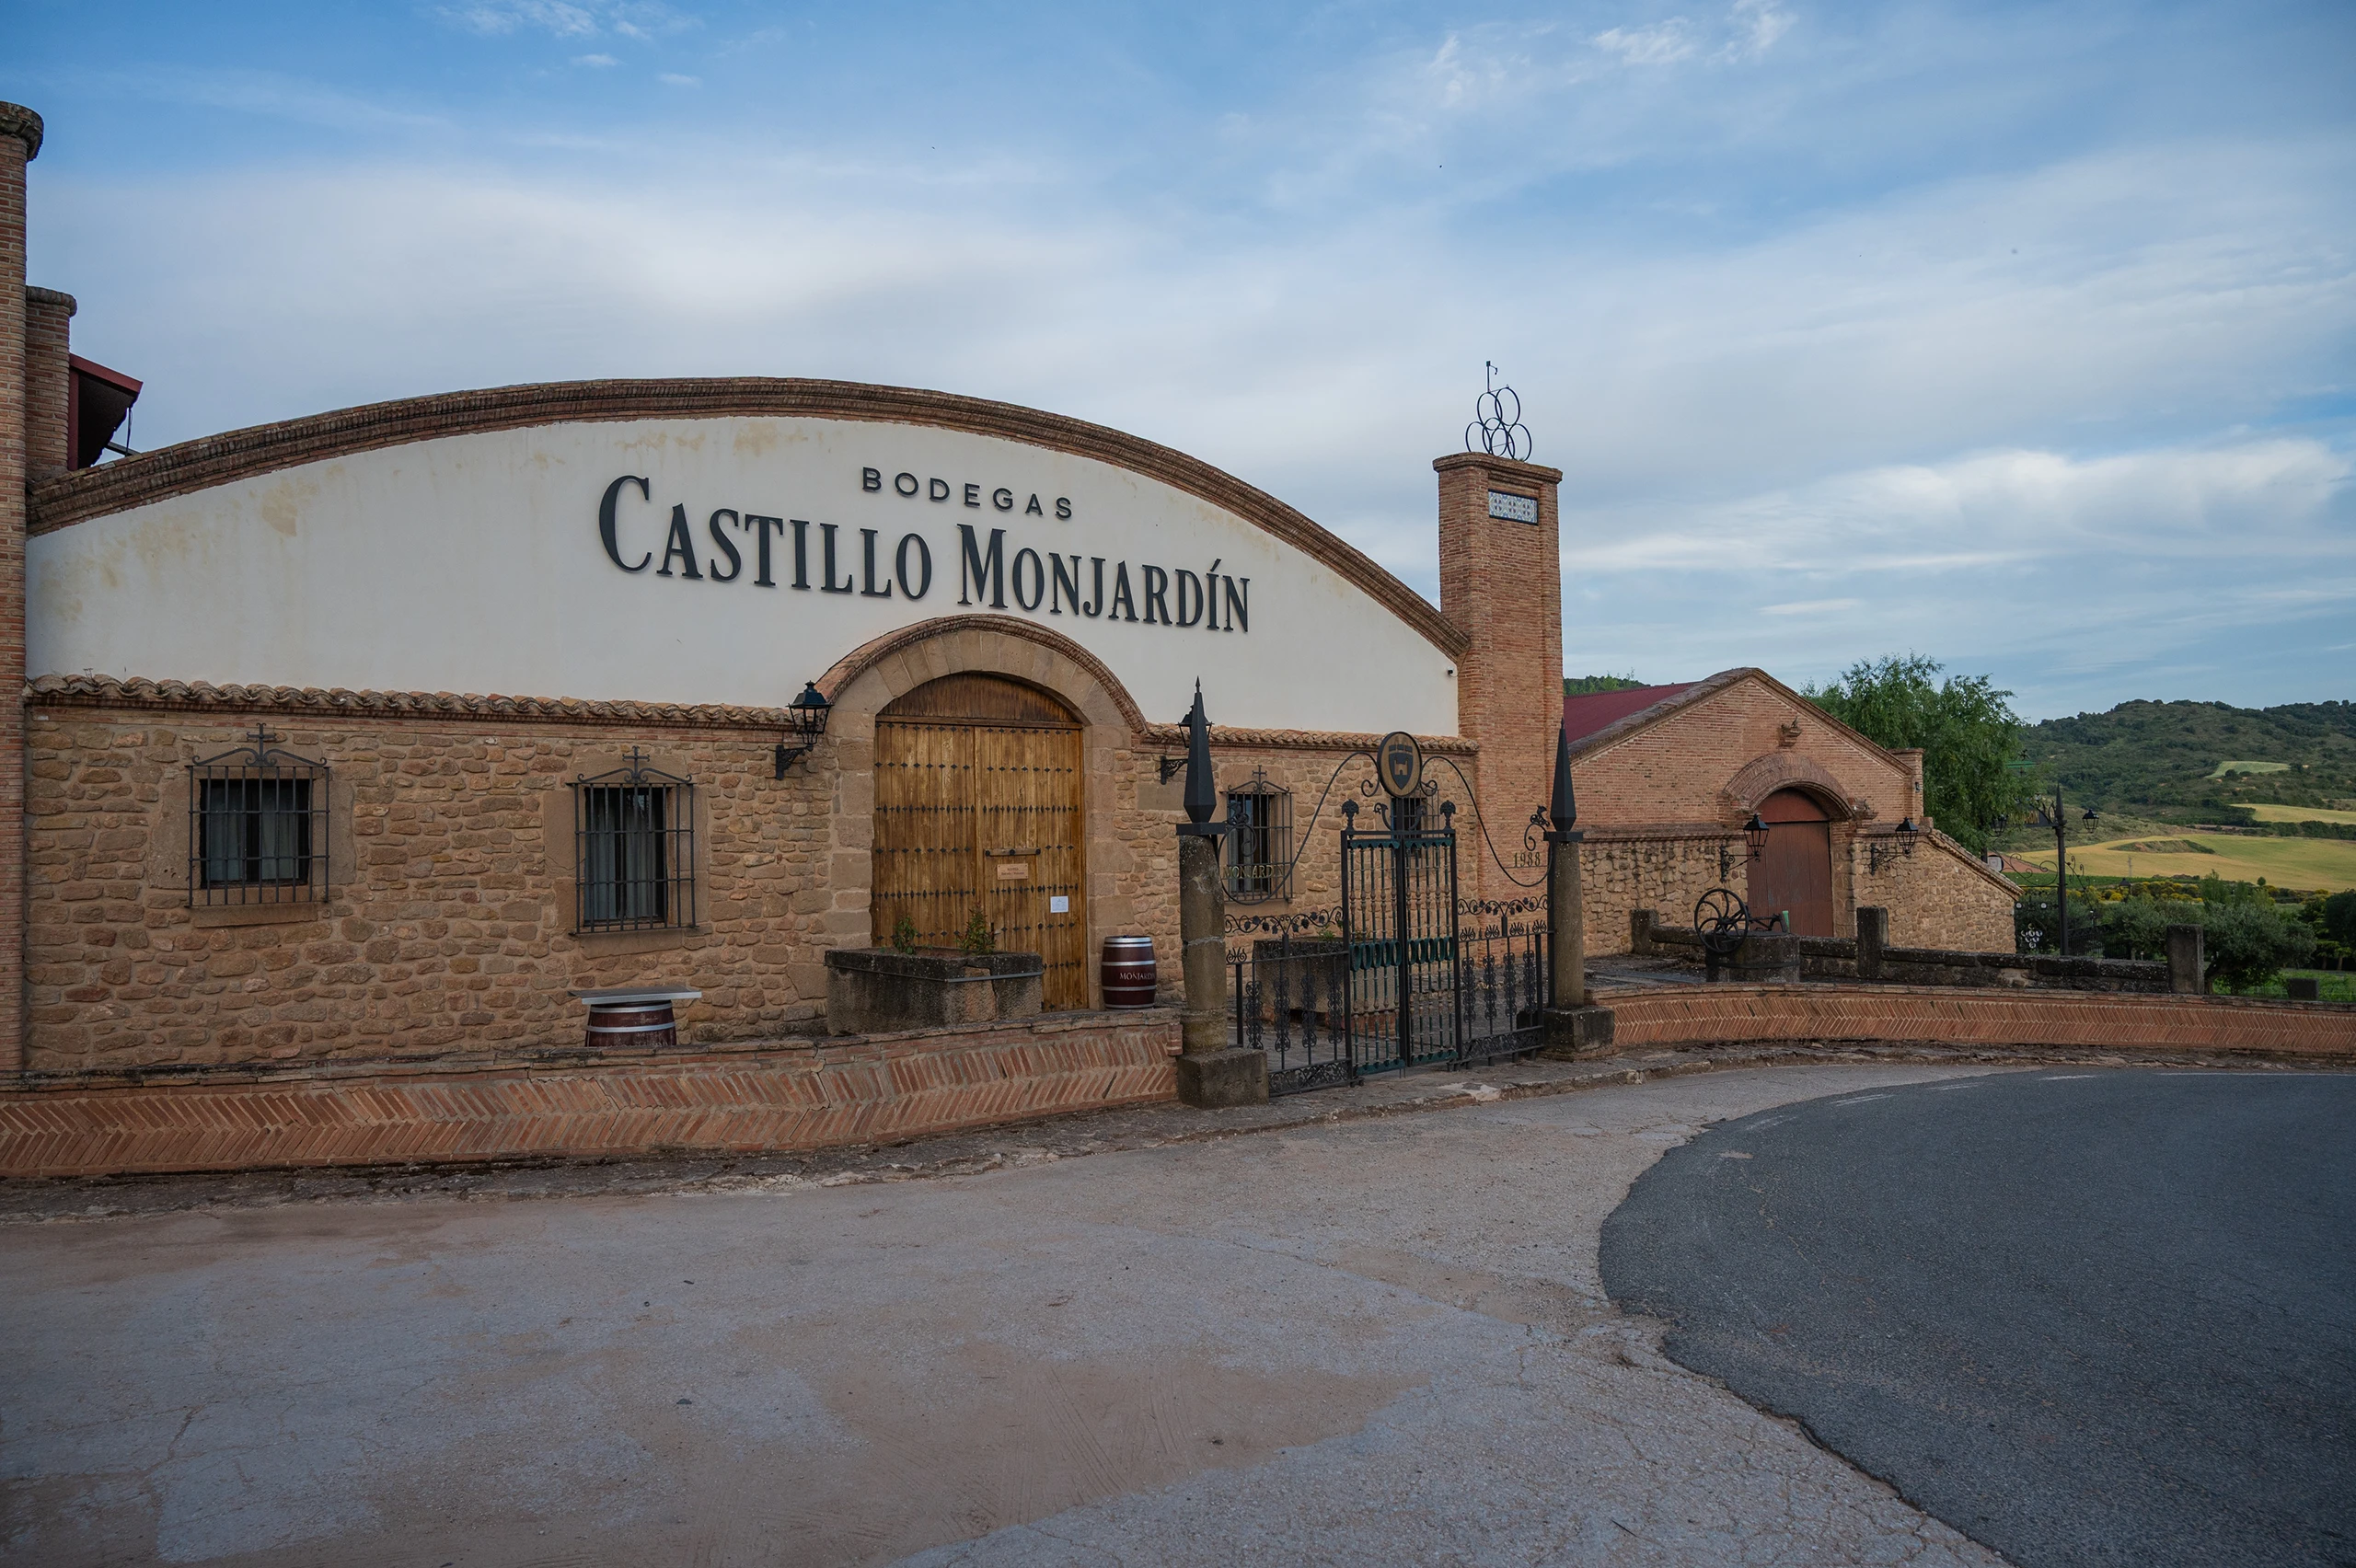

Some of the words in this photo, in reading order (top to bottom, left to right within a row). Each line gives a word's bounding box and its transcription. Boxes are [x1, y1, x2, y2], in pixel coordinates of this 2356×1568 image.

[862, 467, 1073, 520] BODEGAS
[599, 475, 932, 602] CASTILLO
[956, 523, 1251, 633] MONJARDÍN
[1514, 852, 1541, 868] 1988
